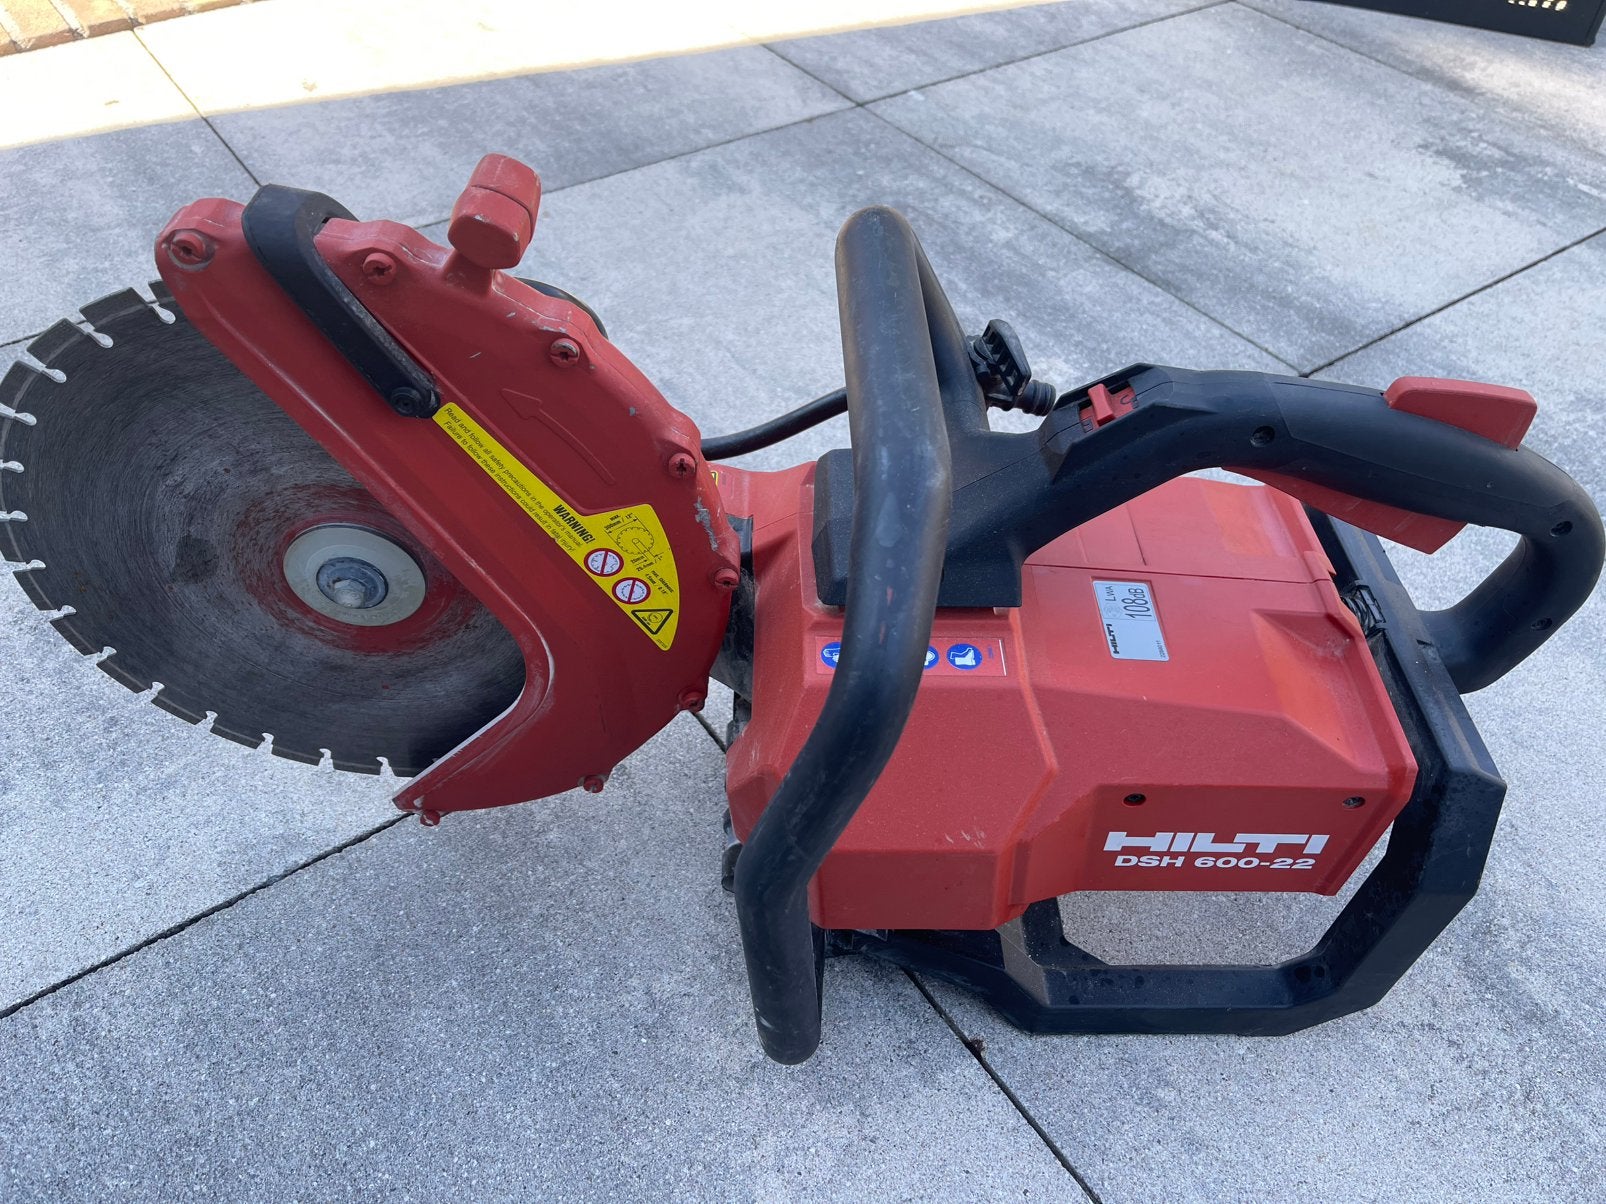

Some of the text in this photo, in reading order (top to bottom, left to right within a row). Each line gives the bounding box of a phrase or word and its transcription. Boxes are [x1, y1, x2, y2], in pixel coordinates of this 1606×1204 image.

[445, 408, 461, 423] Read
[459, 422, 470, 433] and
[469, 433, 483, 447] follow
[490, 454, 505, 470] safety
[503, 470, 532, 497] precautions
[534, 500, 545, 509] the
[445, 421, 462, 439] Failure
[468, 445, 482, 459] follow
[481, 460, 495, 473] these
[495, 473, 521, 499] instructions
[520, 500, 534, 512] could
[534, 510, 547, 525] result
[553, 504, 596, 544] WARNING!
[1106, 623, 1120, 655] HILTI
[1103, 831, 1330, 854] HILTI
[1114, 855, 1316, 869] DSH 600-22
